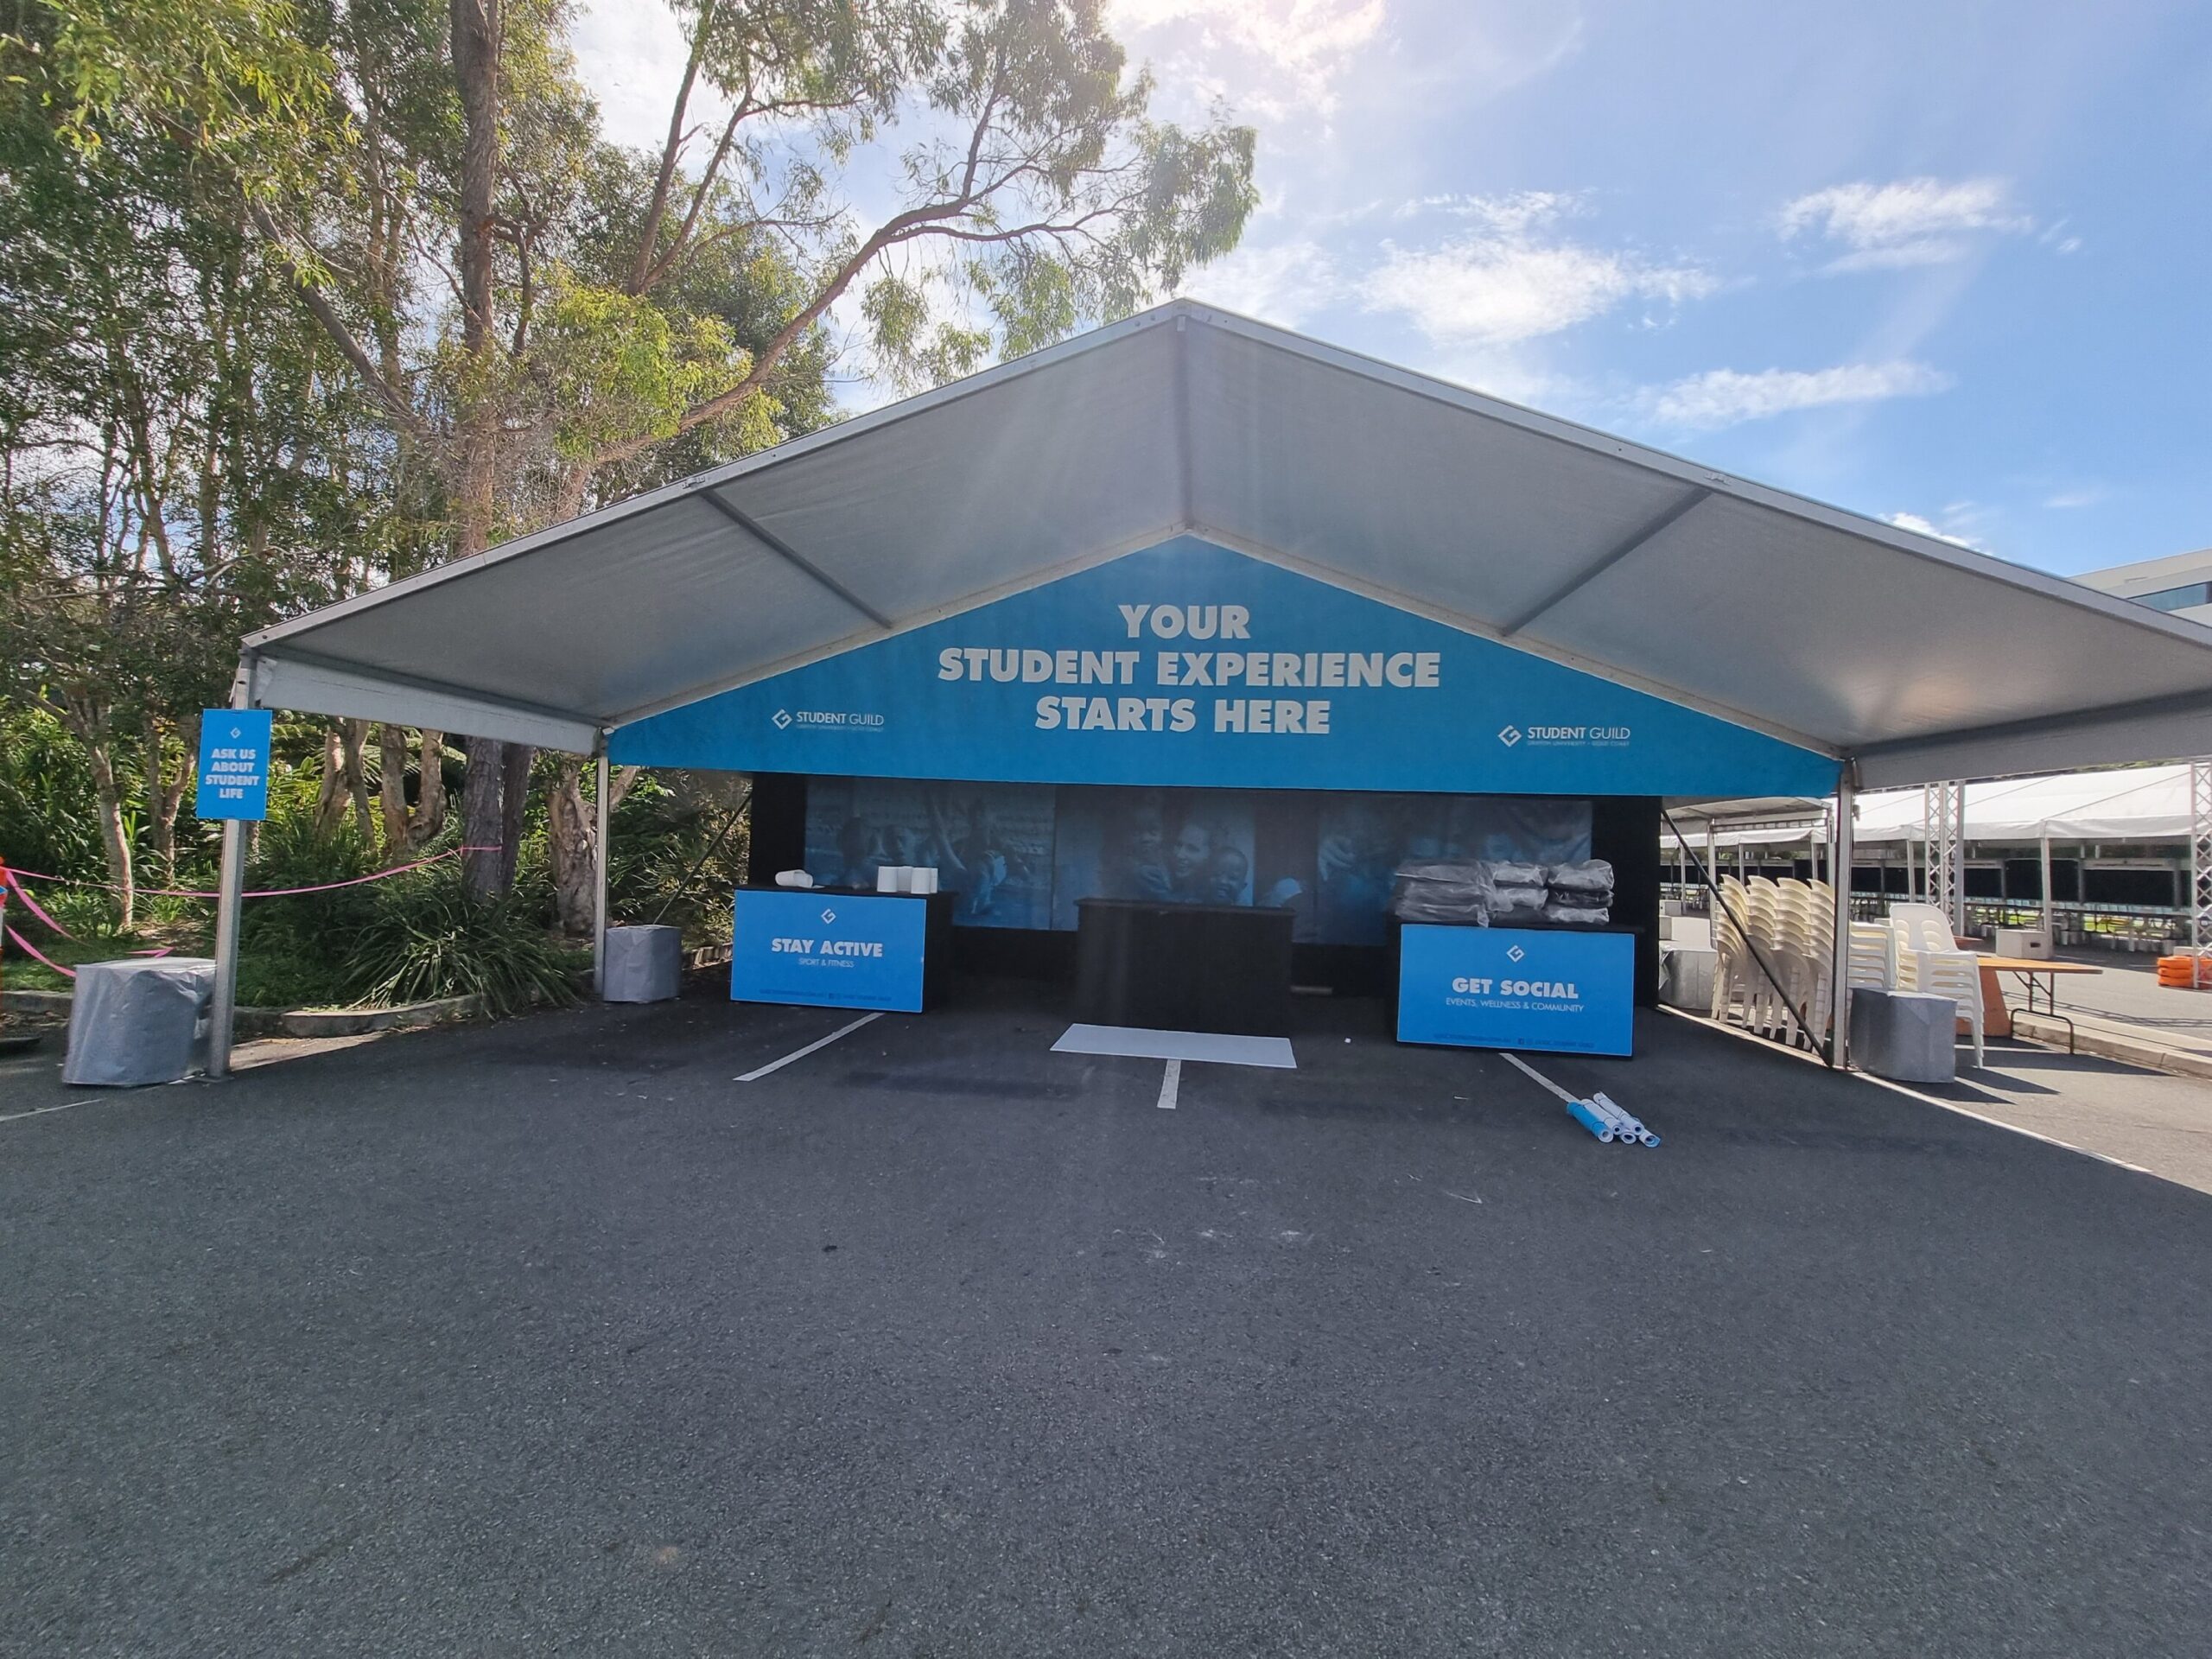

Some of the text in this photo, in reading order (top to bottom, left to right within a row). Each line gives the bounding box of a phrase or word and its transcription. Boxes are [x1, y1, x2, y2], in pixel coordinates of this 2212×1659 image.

[1118, 604, 1250, 639] YOUR
[938, 647, 1440, 688] STUDENT EXPERIENCE
[796, 711, 884, 726] STUDENT GUILD
[1035, 696, 1331, 734] STARTS HERE
[1528, 727, 1630, 740] STUDENT GUILD
[212, 748, 256, 759] ASK US
[212, 761, 255, 772] ABOUT
[205, 774, 259, 785] STUDENT
[219, 788, 243, 798] LIFE
[772, 938, 883, 957] STAY ACTIVE
[828, 959, 855, 968] FITNESS
[1452, 977, 1579, 999] GET SOCIAL
[1480, 999, 1521, 1009] WELLNESS
[1523, 1001, 1529, 1010] &
[1532, 1001, 1585, 1012] COMMUNITY
